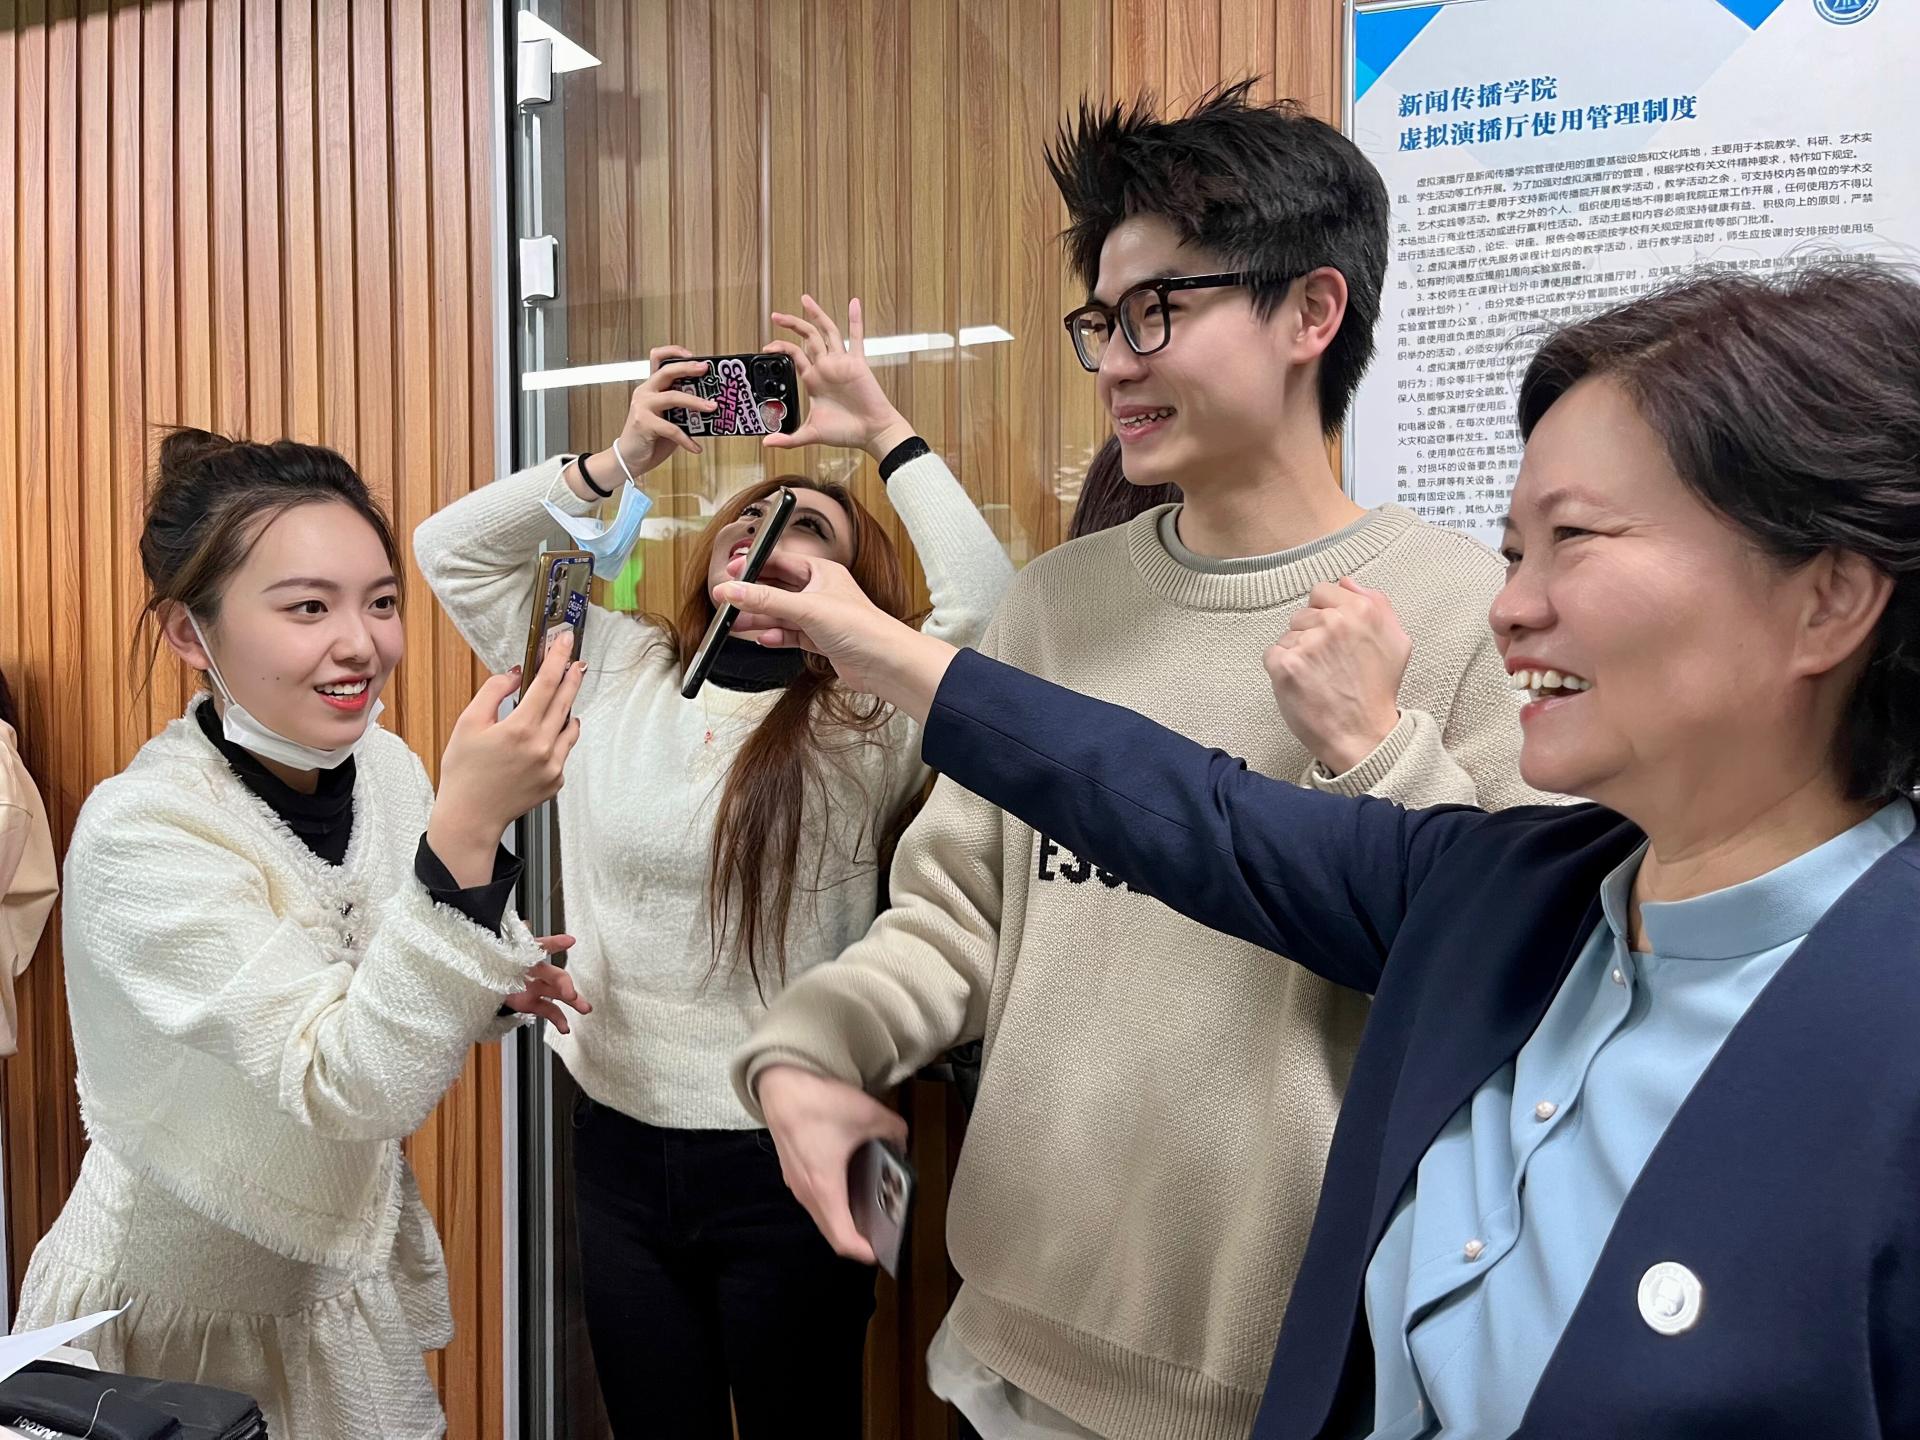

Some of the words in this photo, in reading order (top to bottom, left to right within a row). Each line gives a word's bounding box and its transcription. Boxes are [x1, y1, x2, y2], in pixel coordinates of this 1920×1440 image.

[1398, 76, 1557, 117] 新闻传播学院
[1398, 95, 1697, 152] 虚拟演播厅使用管理制度
